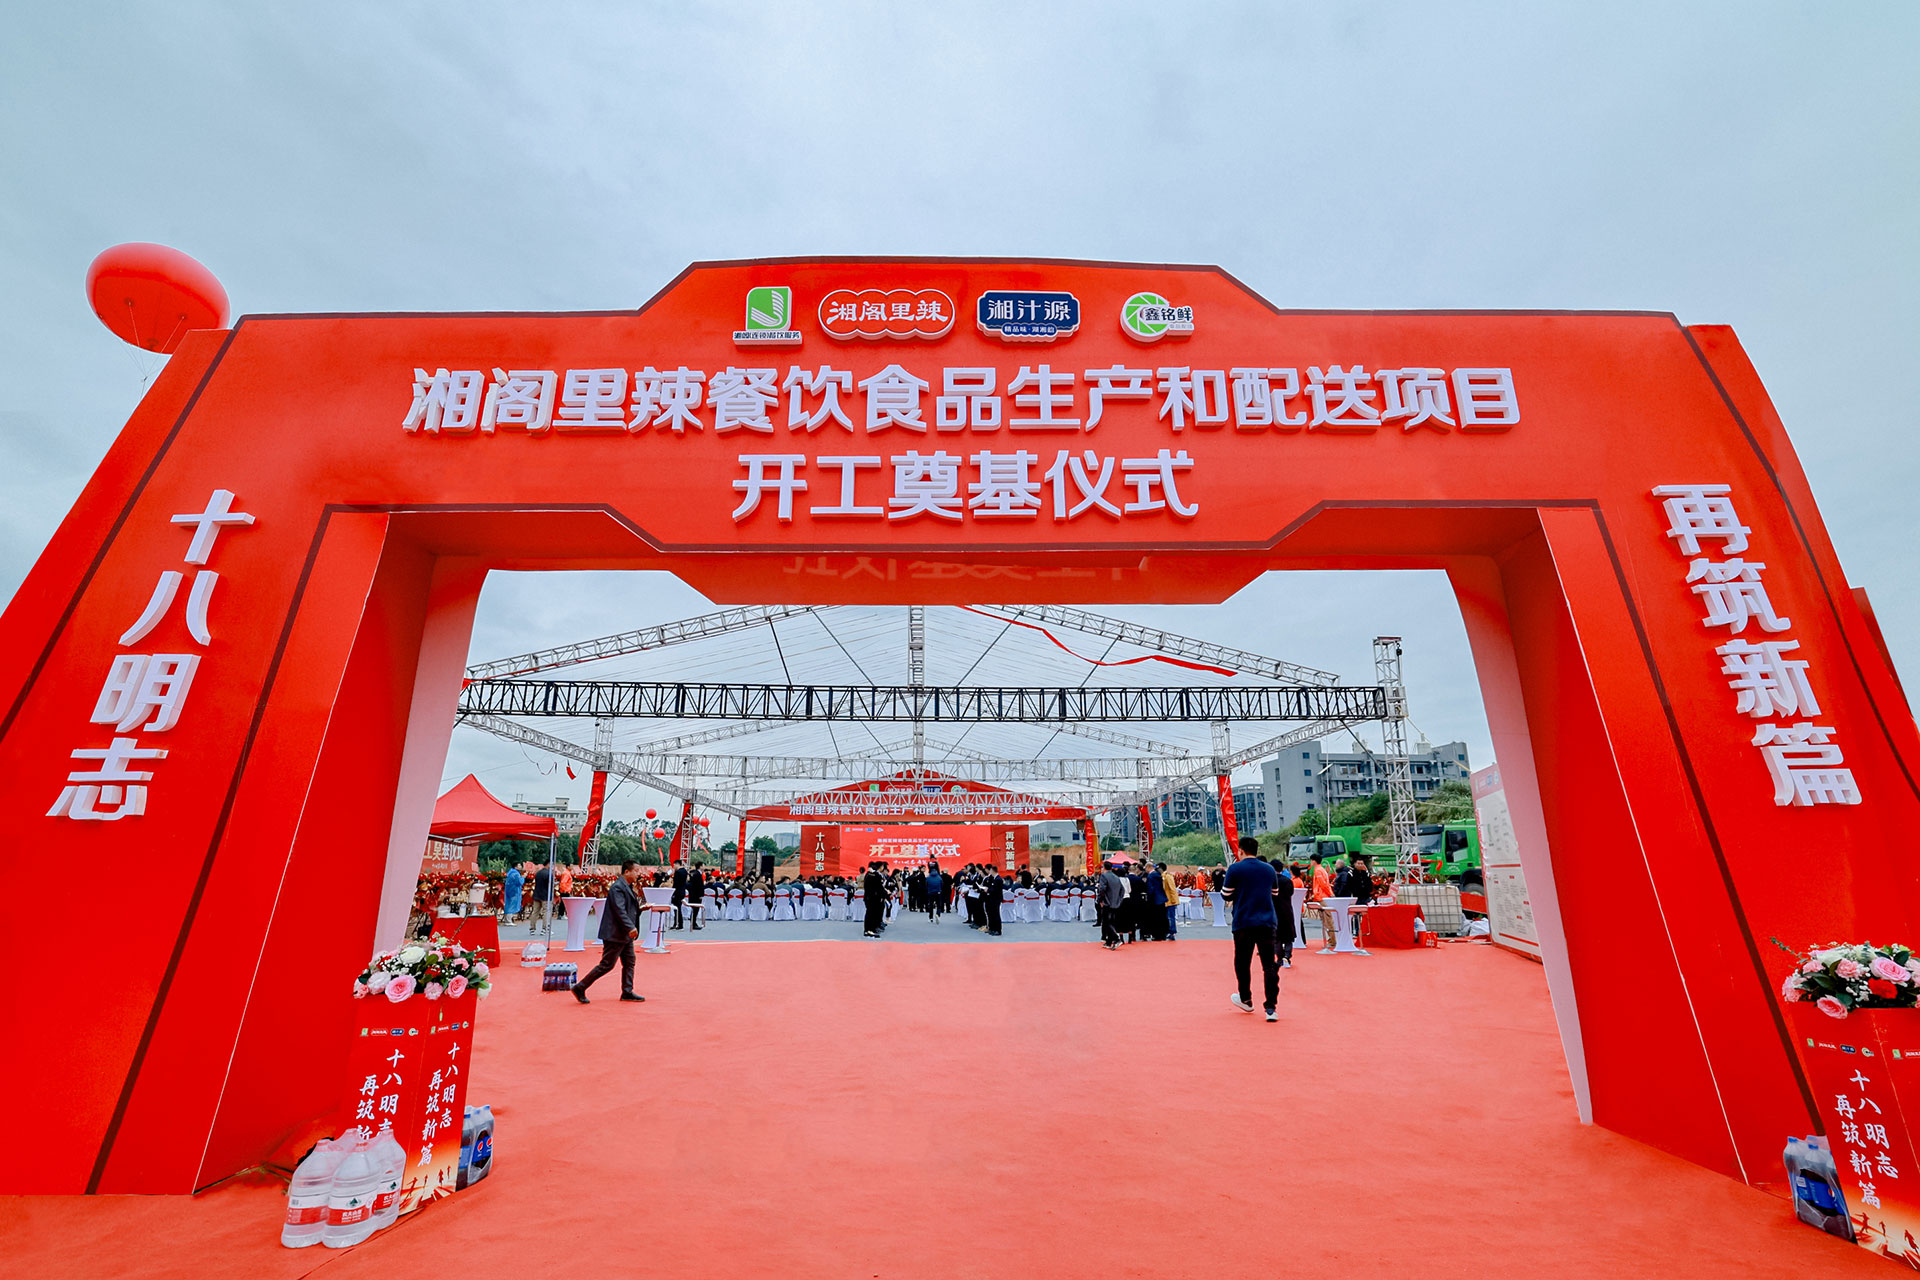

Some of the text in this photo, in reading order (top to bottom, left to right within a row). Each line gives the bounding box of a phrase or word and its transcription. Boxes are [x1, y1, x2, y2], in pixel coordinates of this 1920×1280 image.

[826, 300, 949, 325] 湘阁里辣
[986, 299, 1072, 321] 湘汁源
[1145, 307, 1192, 321] 鑫铭鲜
[402, 364, 1521, 434] 湘阁里辣餐饮食品生产和配送项目
[732, 448, 1200, 522] 开工奠基仪式
[45, 489, 256, 821] 十八明志
[1651, 484, 1863, 807] 再筑新篇
[814, 832, 825, 872] 十八明志
[869, 844, 960, 857] 开工奠基仪式
[417, 1069, 443, 1167] 再筑新篇
[439, 1042, 460, 1129] 十八明志
[1834, 1094, 1881, 1209] 再筑新篇
[1849, 1069, 1899, 1179] 十八明志
